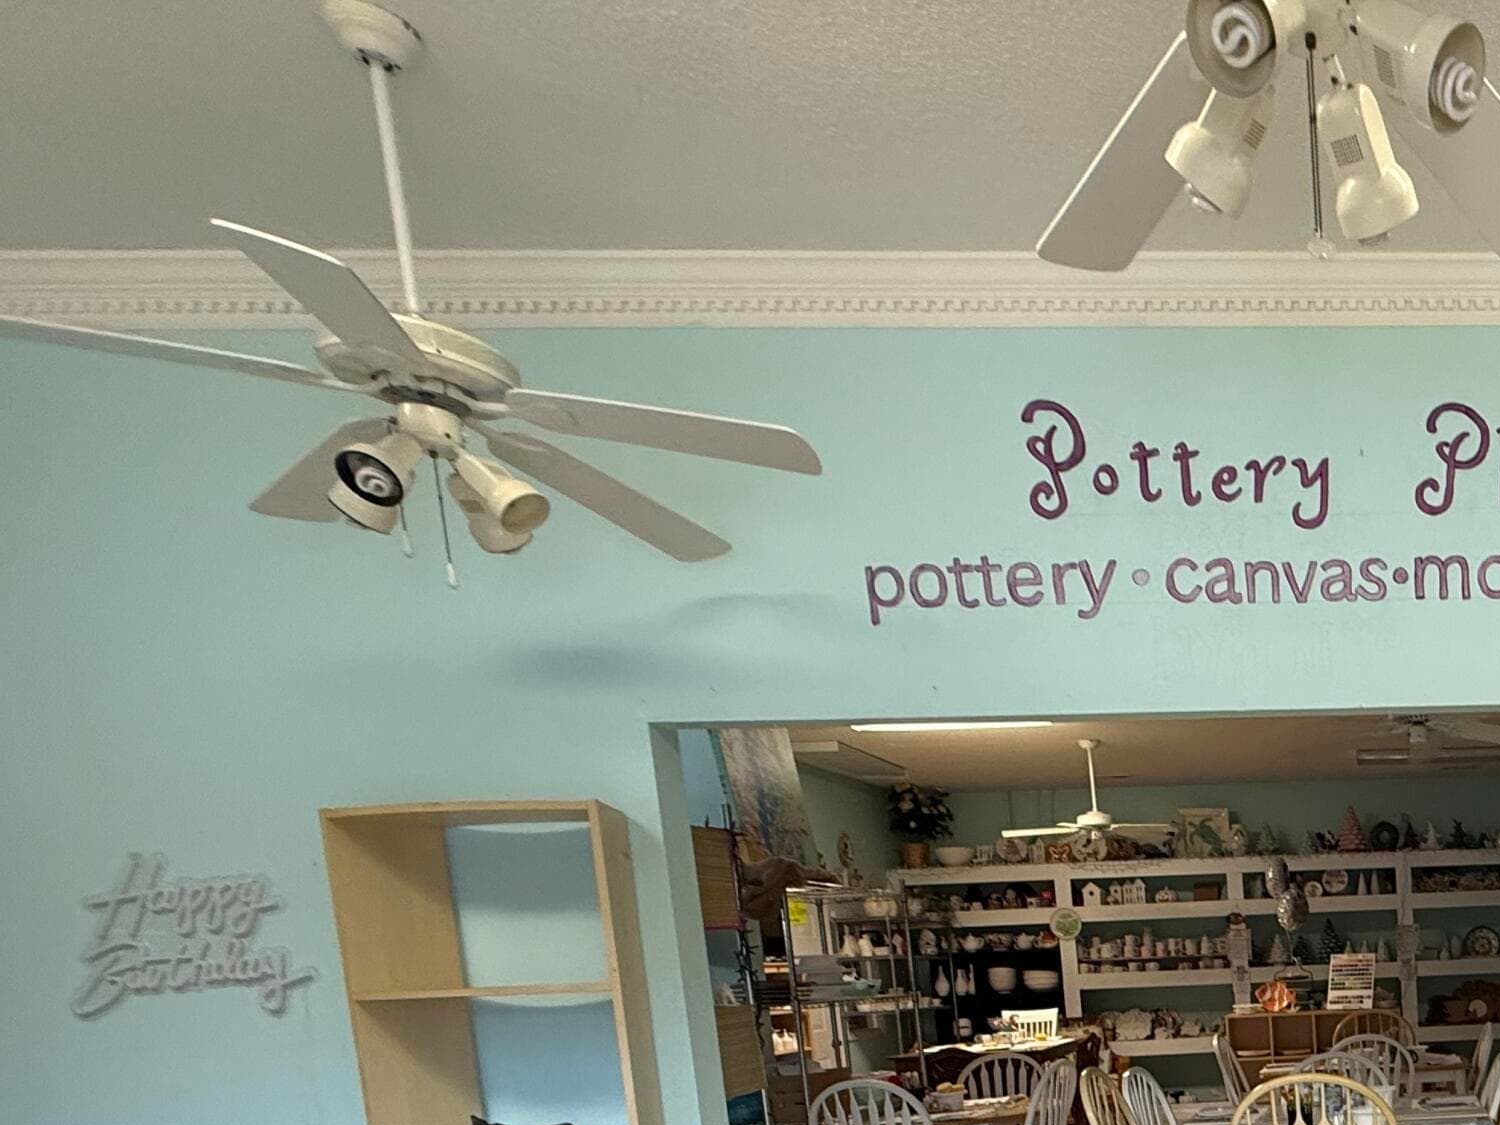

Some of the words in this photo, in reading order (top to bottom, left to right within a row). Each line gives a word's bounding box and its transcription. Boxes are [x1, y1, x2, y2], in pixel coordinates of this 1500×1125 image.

[1021, 400, 1333, 530] Pottery
[865, 553, 1117, 625] pottery
[1164, 553, 1388, 605] canvas
[85, 852, 280, 938] Happy
[72, 940, 317, 1017] Birthday
